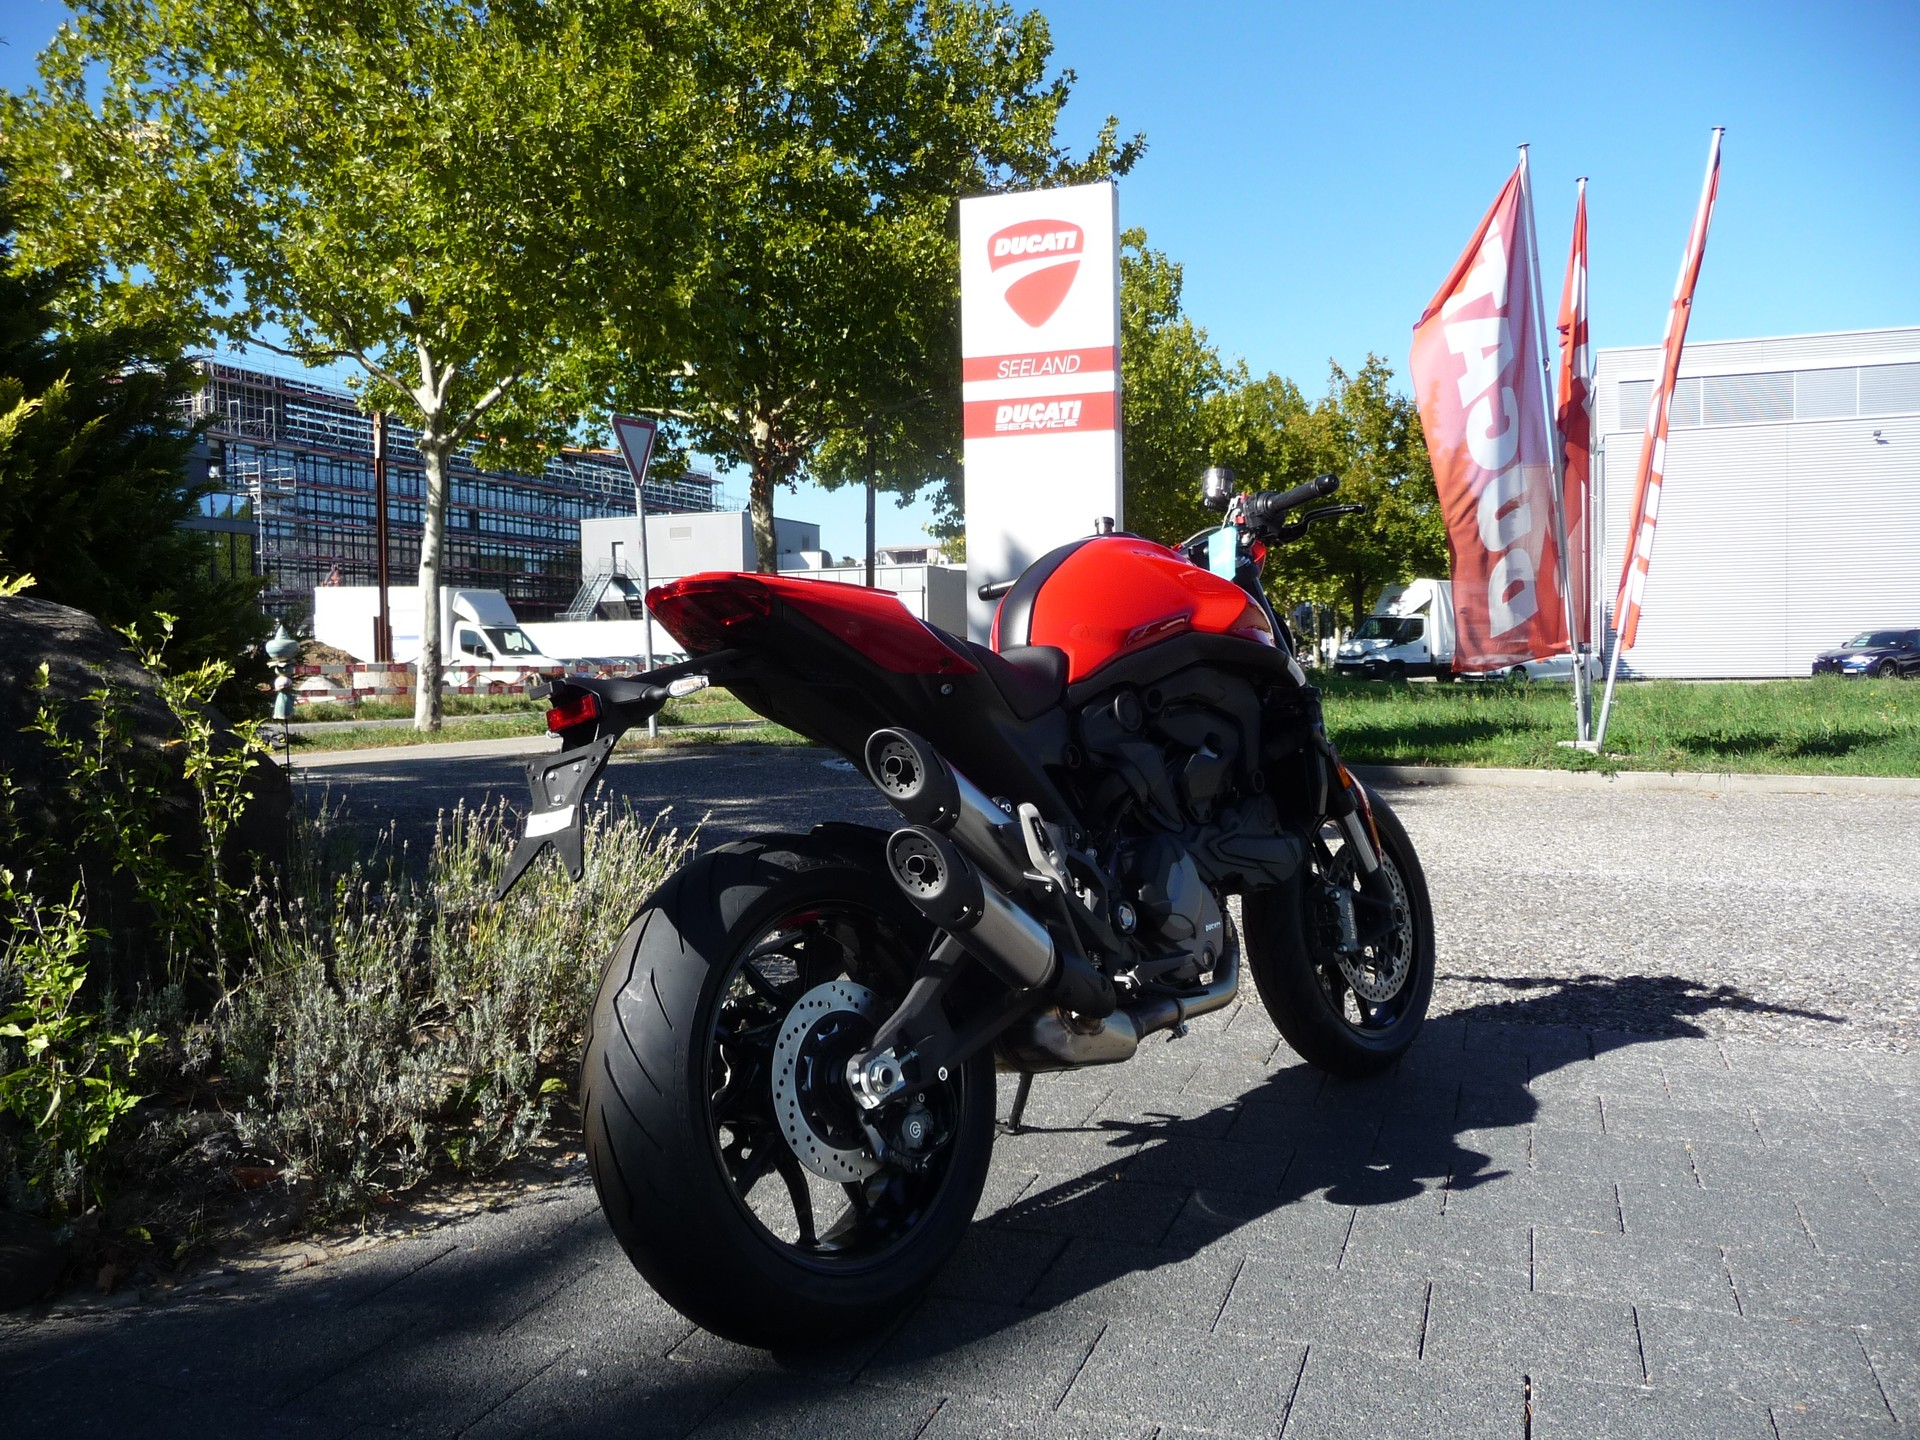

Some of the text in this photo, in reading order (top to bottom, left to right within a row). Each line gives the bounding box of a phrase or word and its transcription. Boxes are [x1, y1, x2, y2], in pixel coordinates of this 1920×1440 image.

[994, 231, 1078, 256] DUCATI
[997, 354, 1080, 379] SEELAND
[995, 400, 1082, 424] DUCATI
[995, 418, 1079, 432] SERVICE
